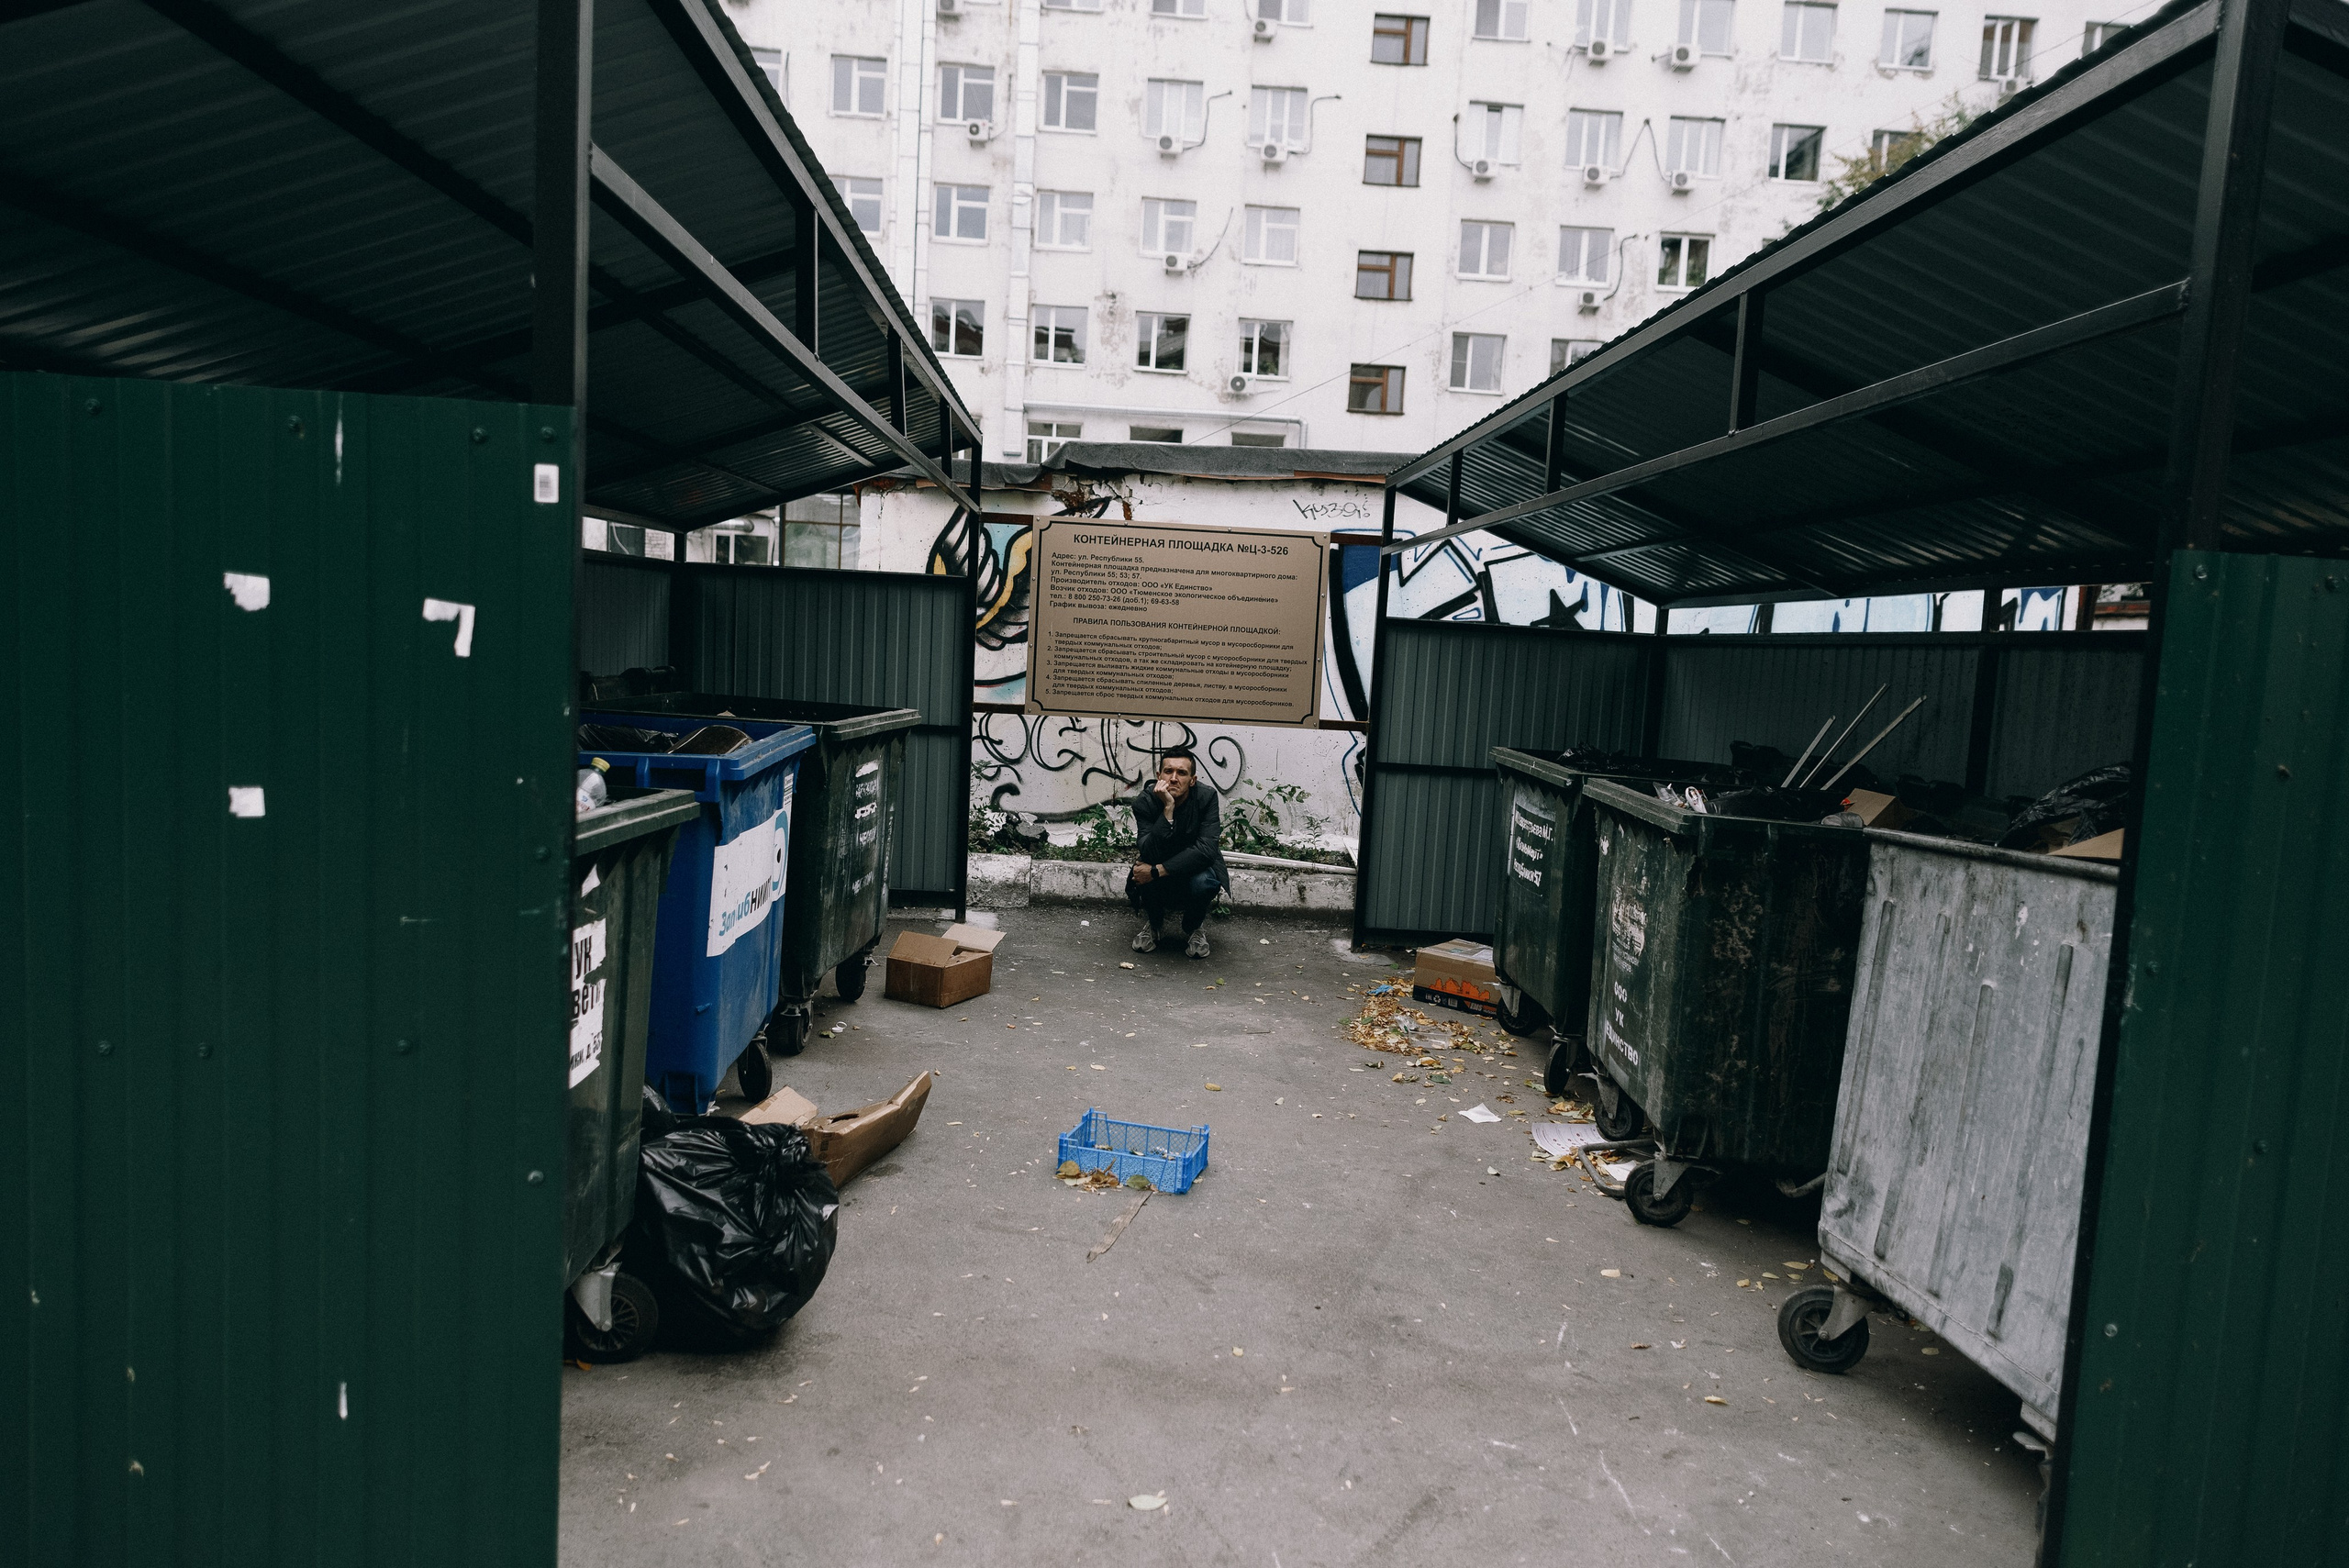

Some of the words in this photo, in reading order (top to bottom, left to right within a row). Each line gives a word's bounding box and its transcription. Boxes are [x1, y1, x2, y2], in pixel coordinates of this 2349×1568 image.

[1073, 533, 1164, 548] КОНТЕЙНЕРНАЯ
[1167, 539, 1234, 553] ПЛОЩАДКА
[1237, 543, 1288, 555] №Ц-3-526
[1051, 551, 1075, 560] Адрес:
[1090, 553, 1132, 562] Республики
[1051, 560, 1101, 569] Контейнерная
[1103, 563, 1139, 572] площадка
[1140, 565, 1194, 574] предназначена
[1210, 570, 1276, 579] многоквартирного
[1063, 568, 1105, 577] Республики
[1050, 575, 1107, 585] Производитель
[1174, 583, 1212, 591] Единство»
[1087, 594, 1120, 602] 250-73-26
[1150, 597, 1179, 606] 69-63-58
[1129, 588, 1173, 596] «Тюменское
[1174, 592, 1226, 600] экологическое
[1227, 594, 1278, 603] объединение»
[1049, 599, 1076, 608] График
[1073, 617, 1108, 625] ПРАВИЛА
[1109, 618, 1166, 628] ПОЛЬЗОВАНИЯ
[1167, 622, 1228, 631] КОНТЕЙНЕРНОЙ
[1230, 625, 1280, 635] ПЛОЩАДКОЙ:
[1054, 630, 1097, 639] Запрещается
[1097, 633, 1137, 641] сбрасывать
[1227, 641, 1280, 650] мусоросборники
[1053, 645, 1097, 653] Запрещается
[1215, 662, 1257, 670] котейнерную
[1052, 673, 1095, 682] Запрещается
[1052, 688, 1094, 696] Запрещается
[574, 935, 592, 980] УК
[1614, 981, 1628, 1003] ООО
[1615, 1007, 1624, 1028] УК
[1606, 1019, 1639, 1066] ЕДИНСТВО
